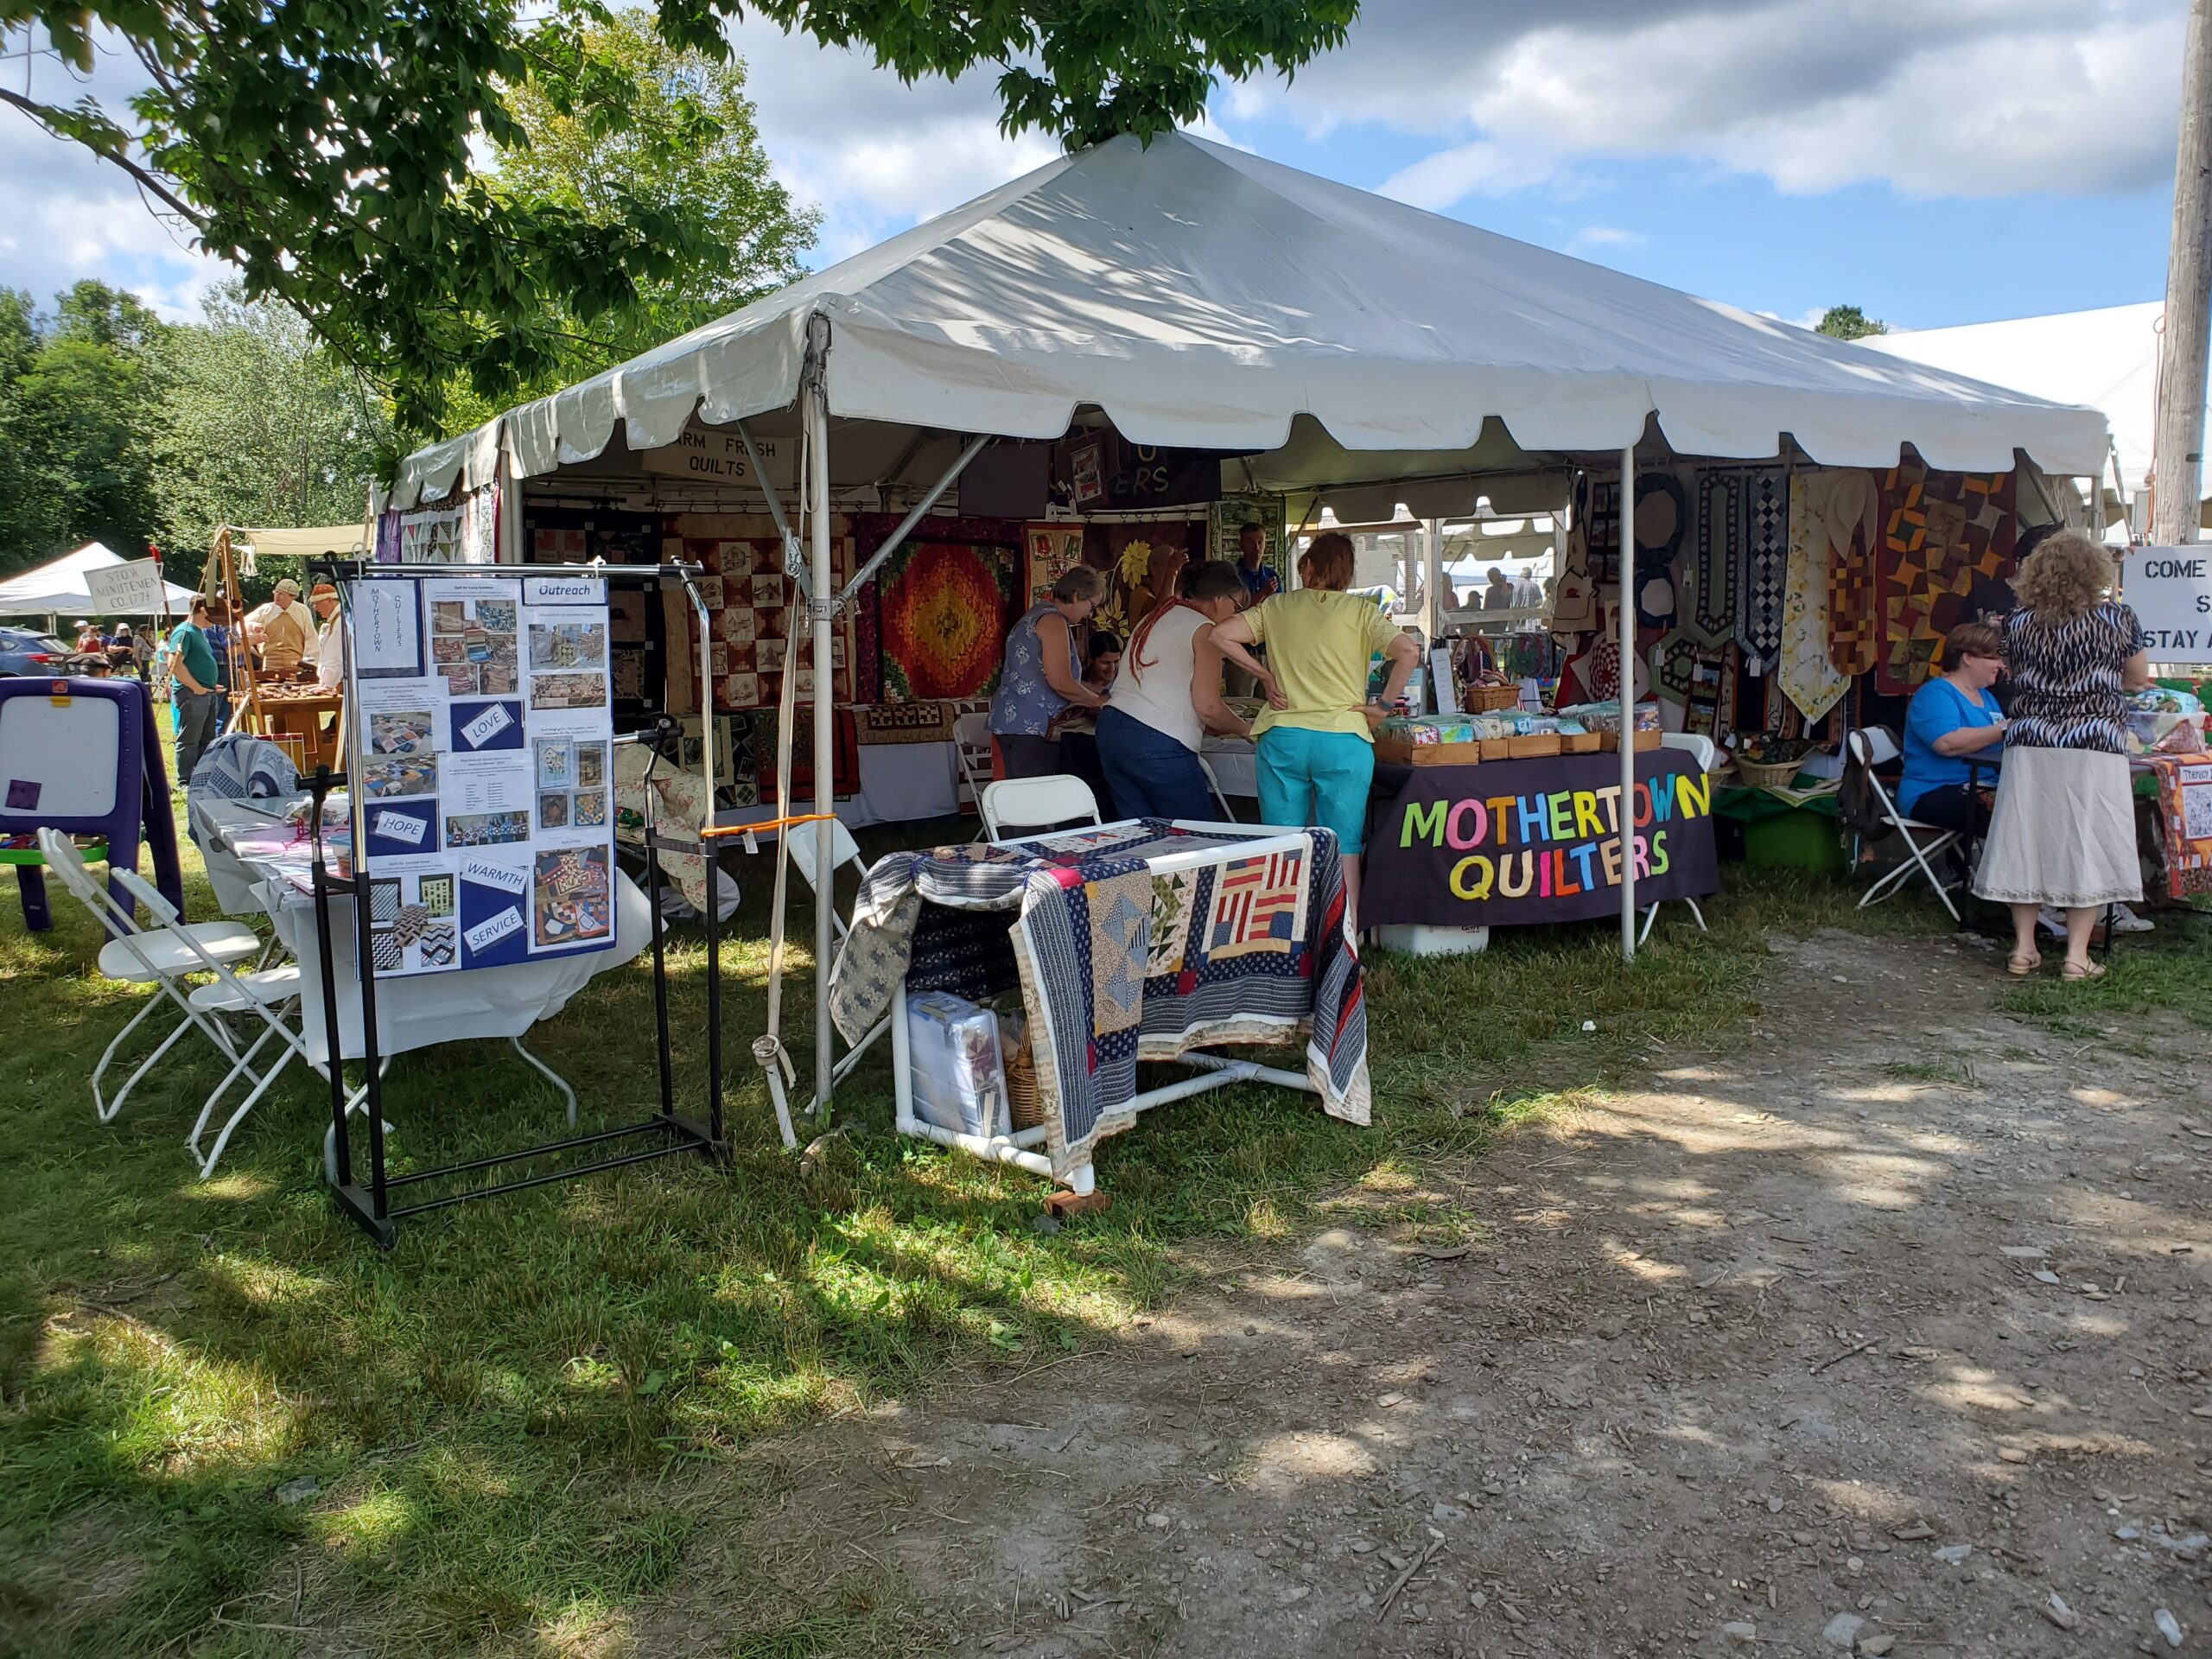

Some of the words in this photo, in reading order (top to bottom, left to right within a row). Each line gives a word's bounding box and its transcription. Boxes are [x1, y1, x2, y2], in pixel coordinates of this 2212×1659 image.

[690, 455, 746, 477] QUILTS
[105, 568, 137, 582] STOW
[2145, 559, 2207, 578] COME
[538, 584, 591, 596] Outreach
[2196, 594, 2212, 613] S
[371, 588, 381, 652] MOTHERTOWN
[394, 594, 404, 647] QUILTERS
[2142, 630, 2199, 648] STAY
[472, 714, 501, 738] LOVE
[1399, 772, 1711, 850] MOTHERTOWN
[383, 817, 422, 836] HOPE
[467, 862, 524, 887] WARMTH
[1449, 830, 1669, 901] QUILTERS
[472, 912, 518, 945] SERVICE
